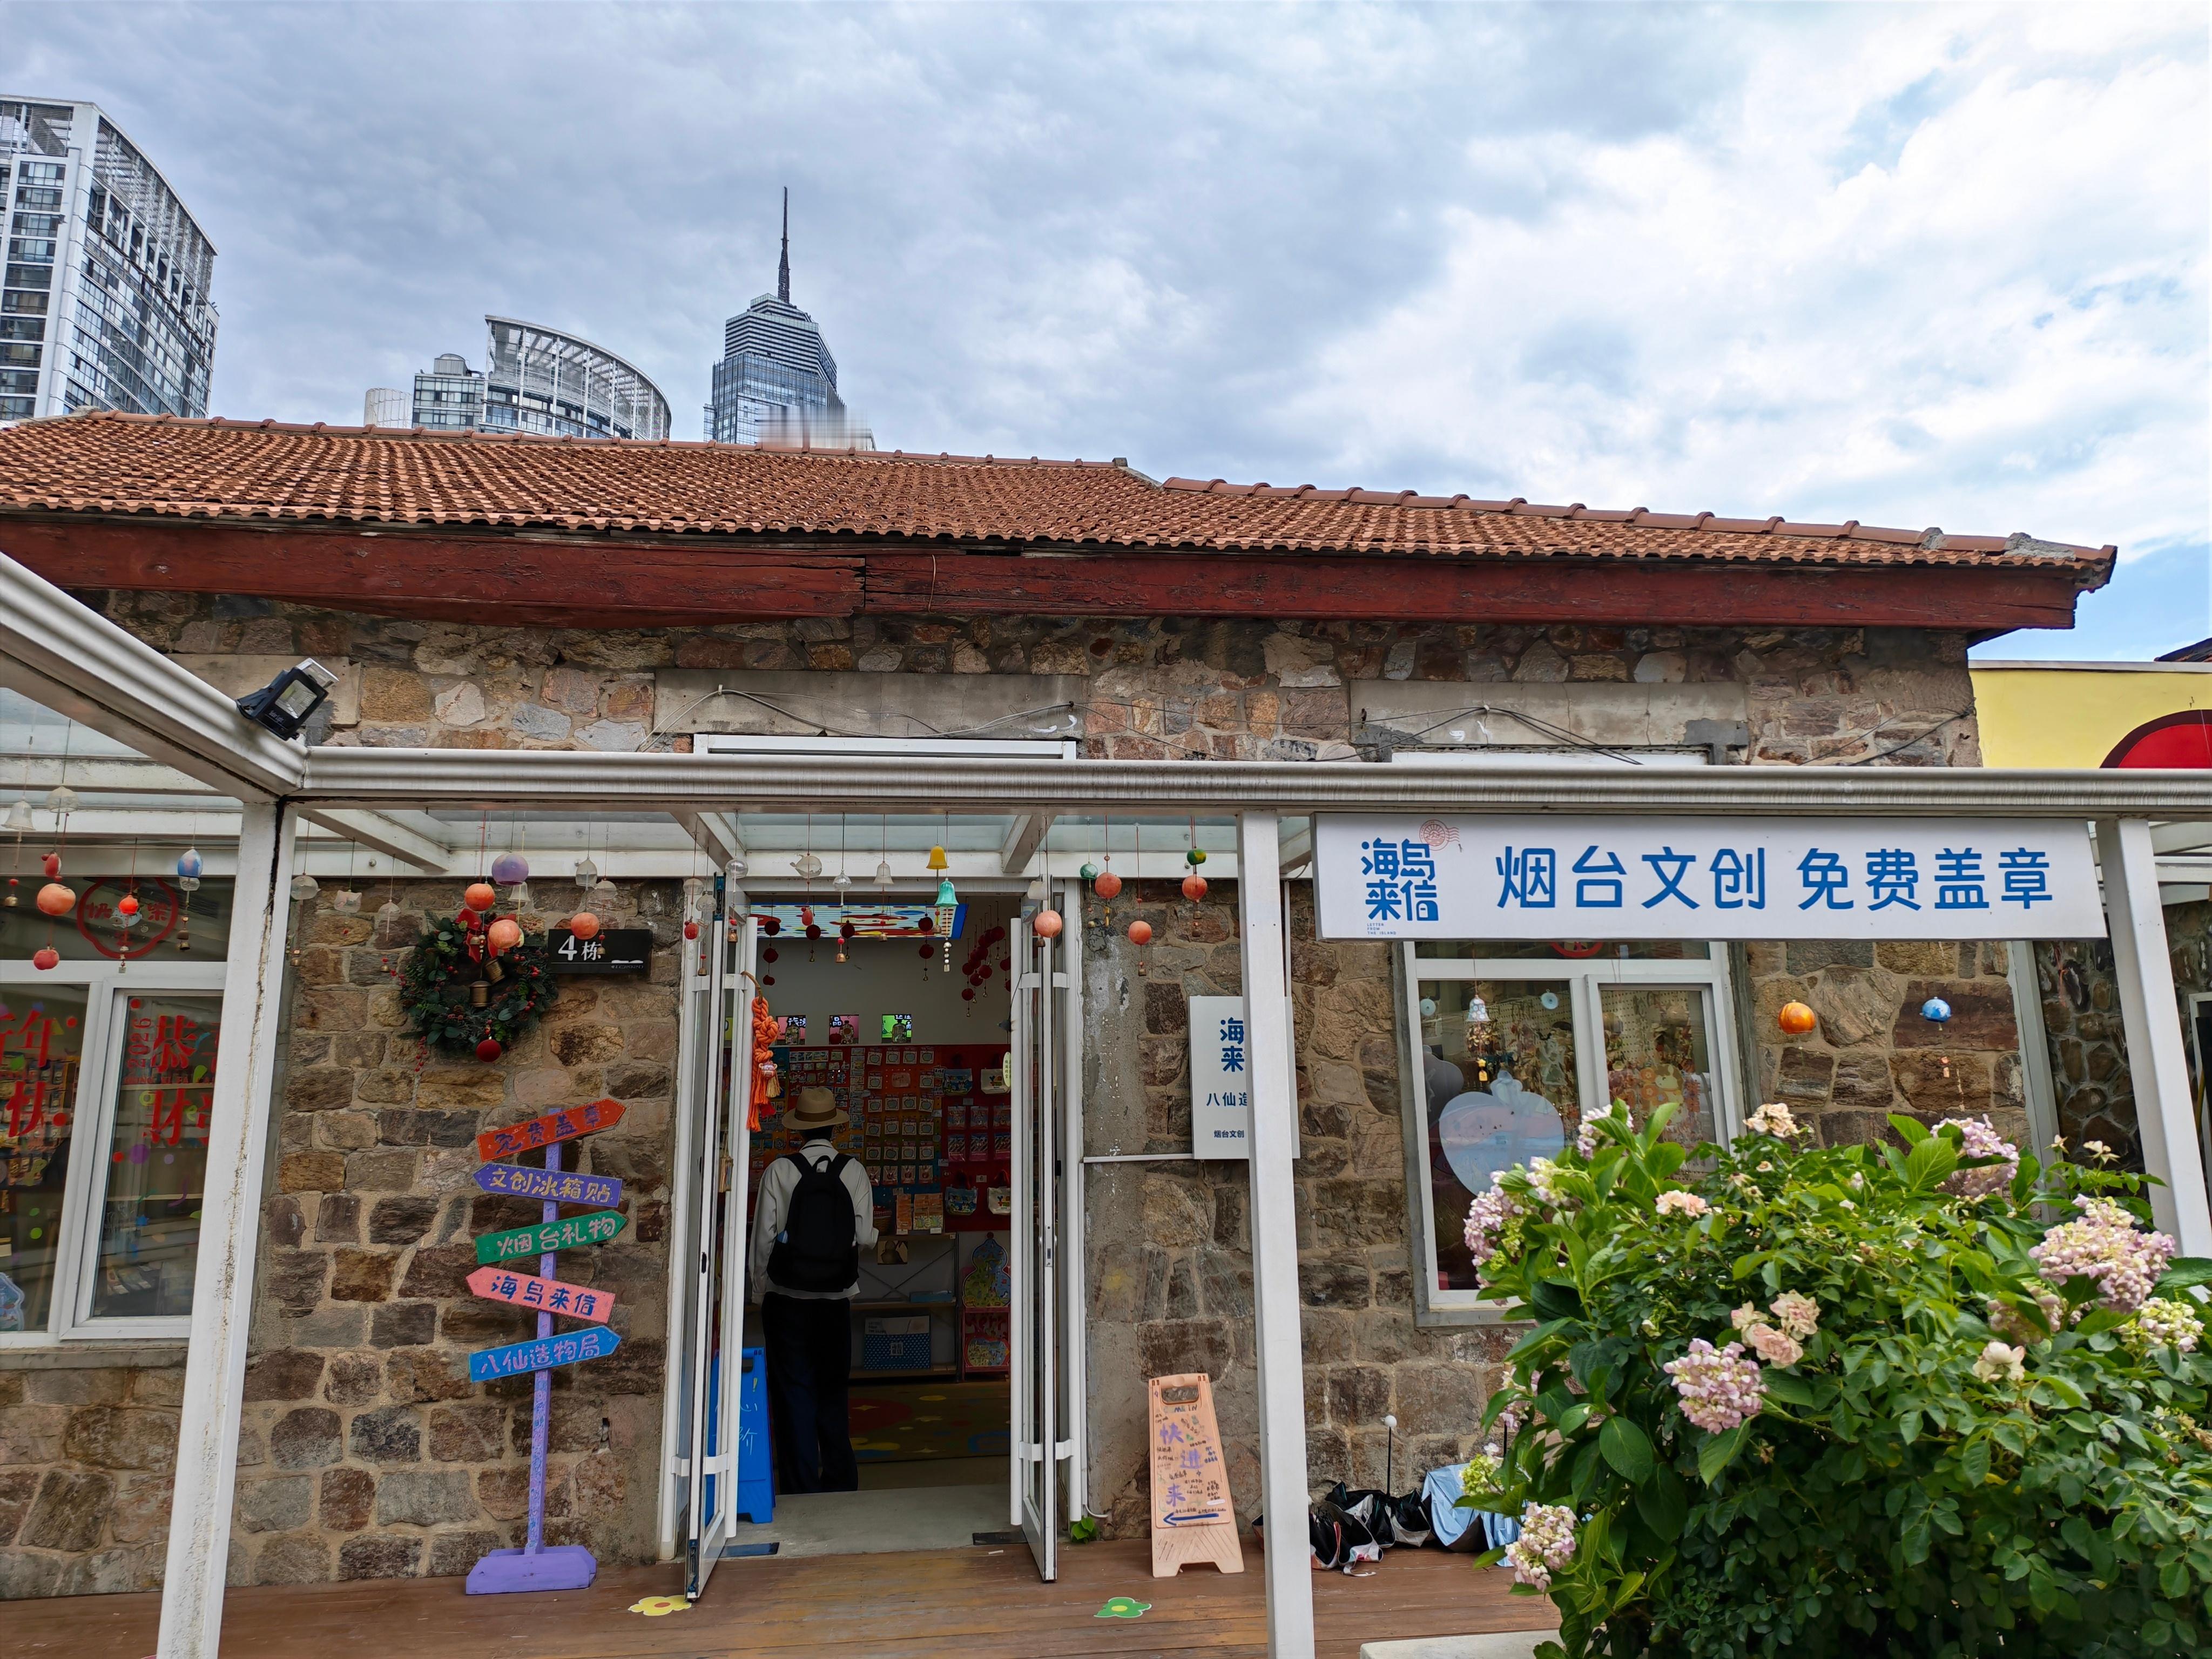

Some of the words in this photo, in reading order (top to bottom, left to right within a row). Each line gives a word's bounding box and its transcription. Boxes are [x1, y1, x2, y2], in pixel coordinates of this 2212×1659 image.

[1361, 837, 1435, 881] 海岛
[1496, 845, 1766, 911] 烟台文创
[1797, 847, 2054, 912] 免费盖章
[1365, 879, 1439, 921] 来信
[1221, 1046, 1245, 1072] 来
[490, 1168, 611, 1204] 文创冰箱贴
[497, 1217, 616, 1257] 烟台礼物
[491, 1275, 597, 1317] 海岛来信
[481, 1333, 601, 1374] 八仙造物局
